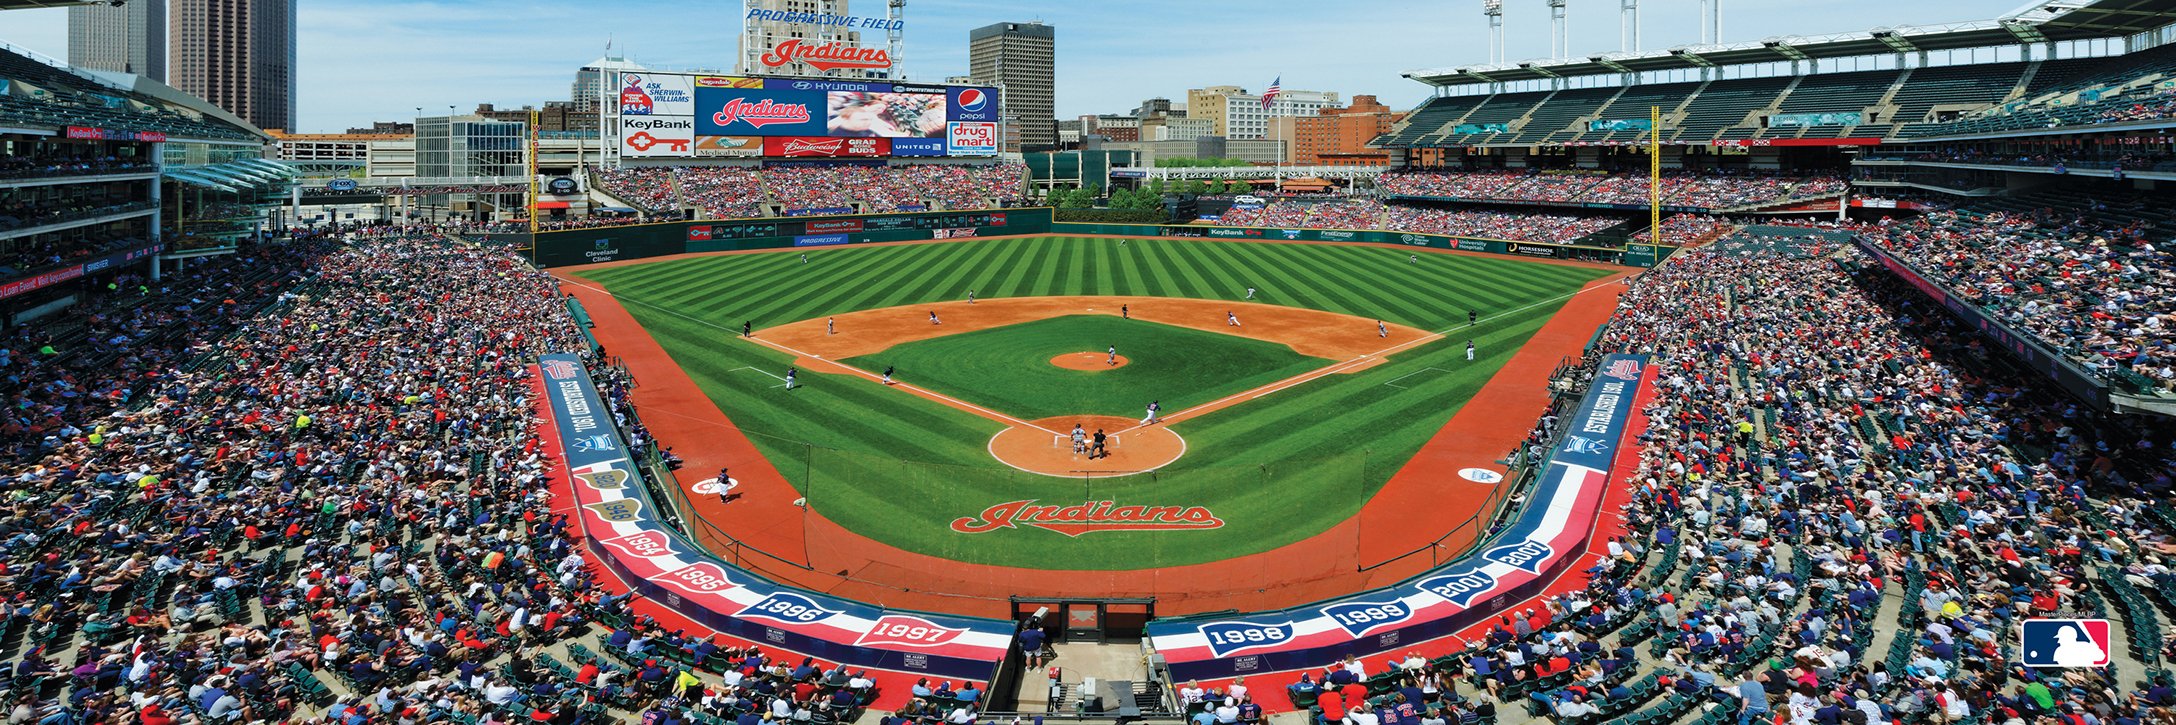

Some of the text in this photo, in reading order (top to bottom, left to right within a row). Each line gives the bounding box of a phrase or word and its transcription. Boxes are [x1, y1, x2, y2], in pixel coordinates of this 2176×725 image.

[747, 8, 904, 31] PROGRESSIVE FIELD
[761, 39, 892, 71] Indians
[815, 83, 868, 91] HYUNDAI
[654, 95, 690, 103] WILLIAMS
[713, 97, 811, 129] Indians
[624, 119, 691, 131] KeyBank
[954, 123, 987, 138] drug
[783, 141, 842, 152] Budweiser
[957, 137, 995, 146] mart
[800, 236, 842, 244] PROGRESSIVE
[1459, 239, 1487, 247] University
[1518, 245, 1554, 254] HORSESHOE
[585, 249, 619, 257] Cleveland
[4, 285, 18, 297] Loan
[592, 471, 618, 488] 1920
[603, 501, 632, 520] 1948
[950, 499, 1226, 536] Indians
[623, 533, 666, 556] 1954
[1499, 541, 1549, 567] 2007
[674, 566, 725, 591] 1995
[1433, 573, 1492, 597] 2001
[756, 597, 824, 622] 1996
[1335, 604, 1406, 626] 1999
[872, 622, 949, 643] 1997
[1213, 626, 1286, 646] 1998
